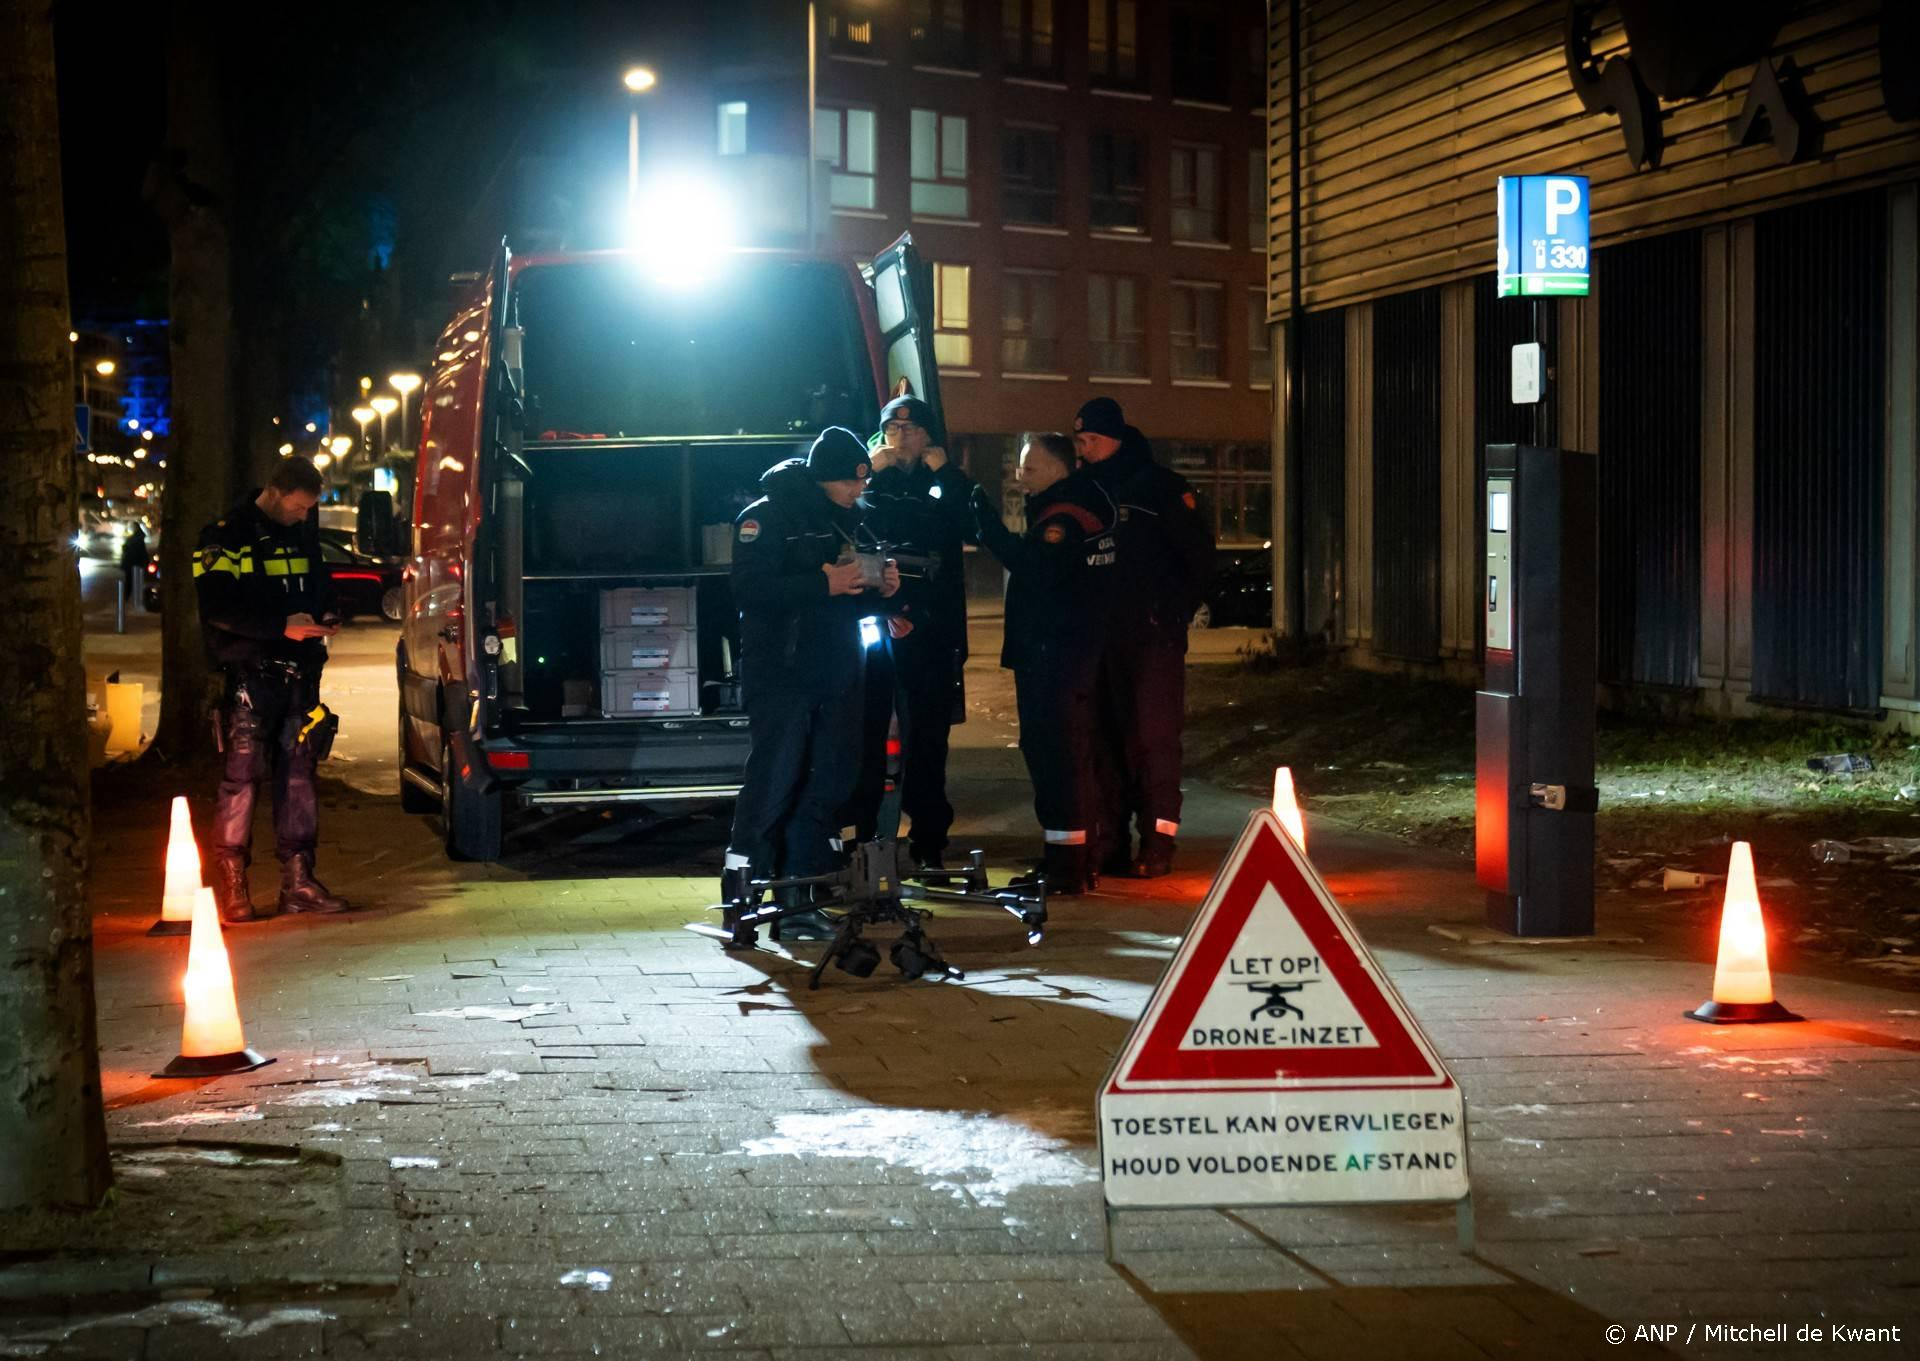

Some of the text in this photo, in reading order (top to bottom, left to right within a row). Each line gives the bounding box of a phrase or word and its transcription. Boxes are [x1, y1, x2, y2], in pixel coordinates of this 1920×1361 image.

[1546, 179, 1581, 235] P
[1230, 954, 1321, 975] LET OP!
[1192, 1026, 1364, 1046] DRONE-INZET
[1111, 1112, 1455, 1136] TOESTEL KAN OVERVLIEGEN
[1111, 1151, 1457, 1176] HOUD VOLDOENDE AFSTAND
